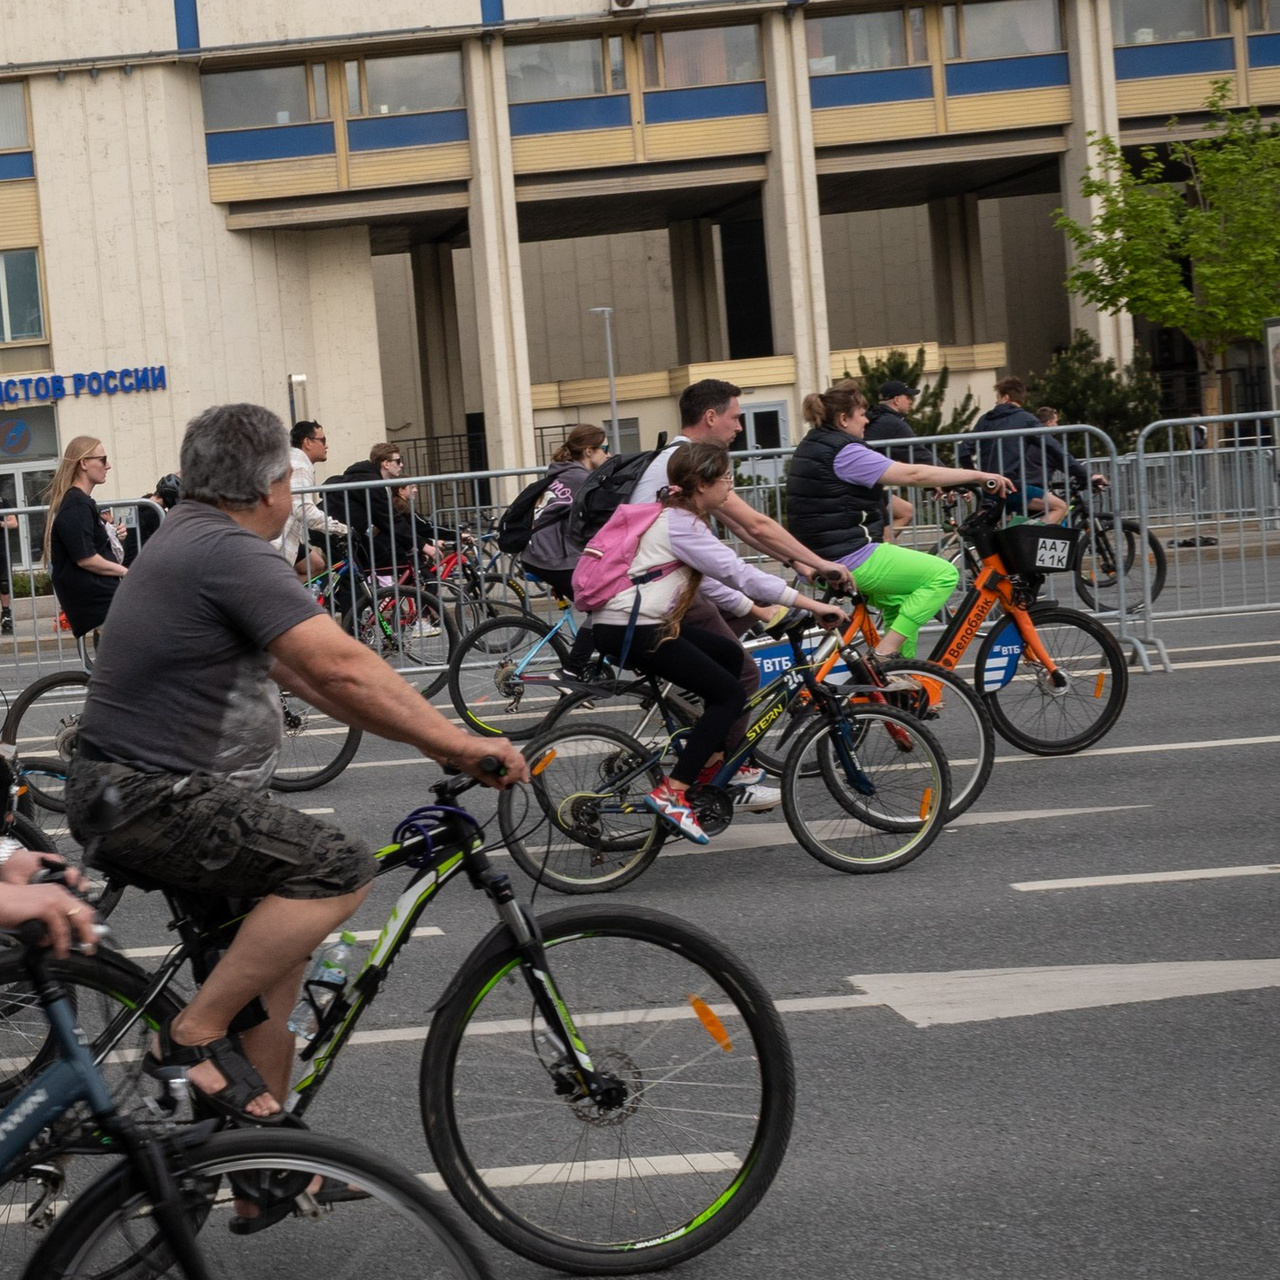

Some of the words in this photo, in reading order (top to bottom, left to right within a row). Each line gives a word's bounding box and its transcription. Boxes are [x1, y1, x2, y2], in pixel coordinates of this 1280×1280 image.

[73, 366, 166, 398] РОССИИ
[948, 598, 992, 658] Велобайк
[762, 656, 792, 673] ВТБ
[1001, 645, 1021, 655] ВТБ
[746, 703, 784, 742] STERN
